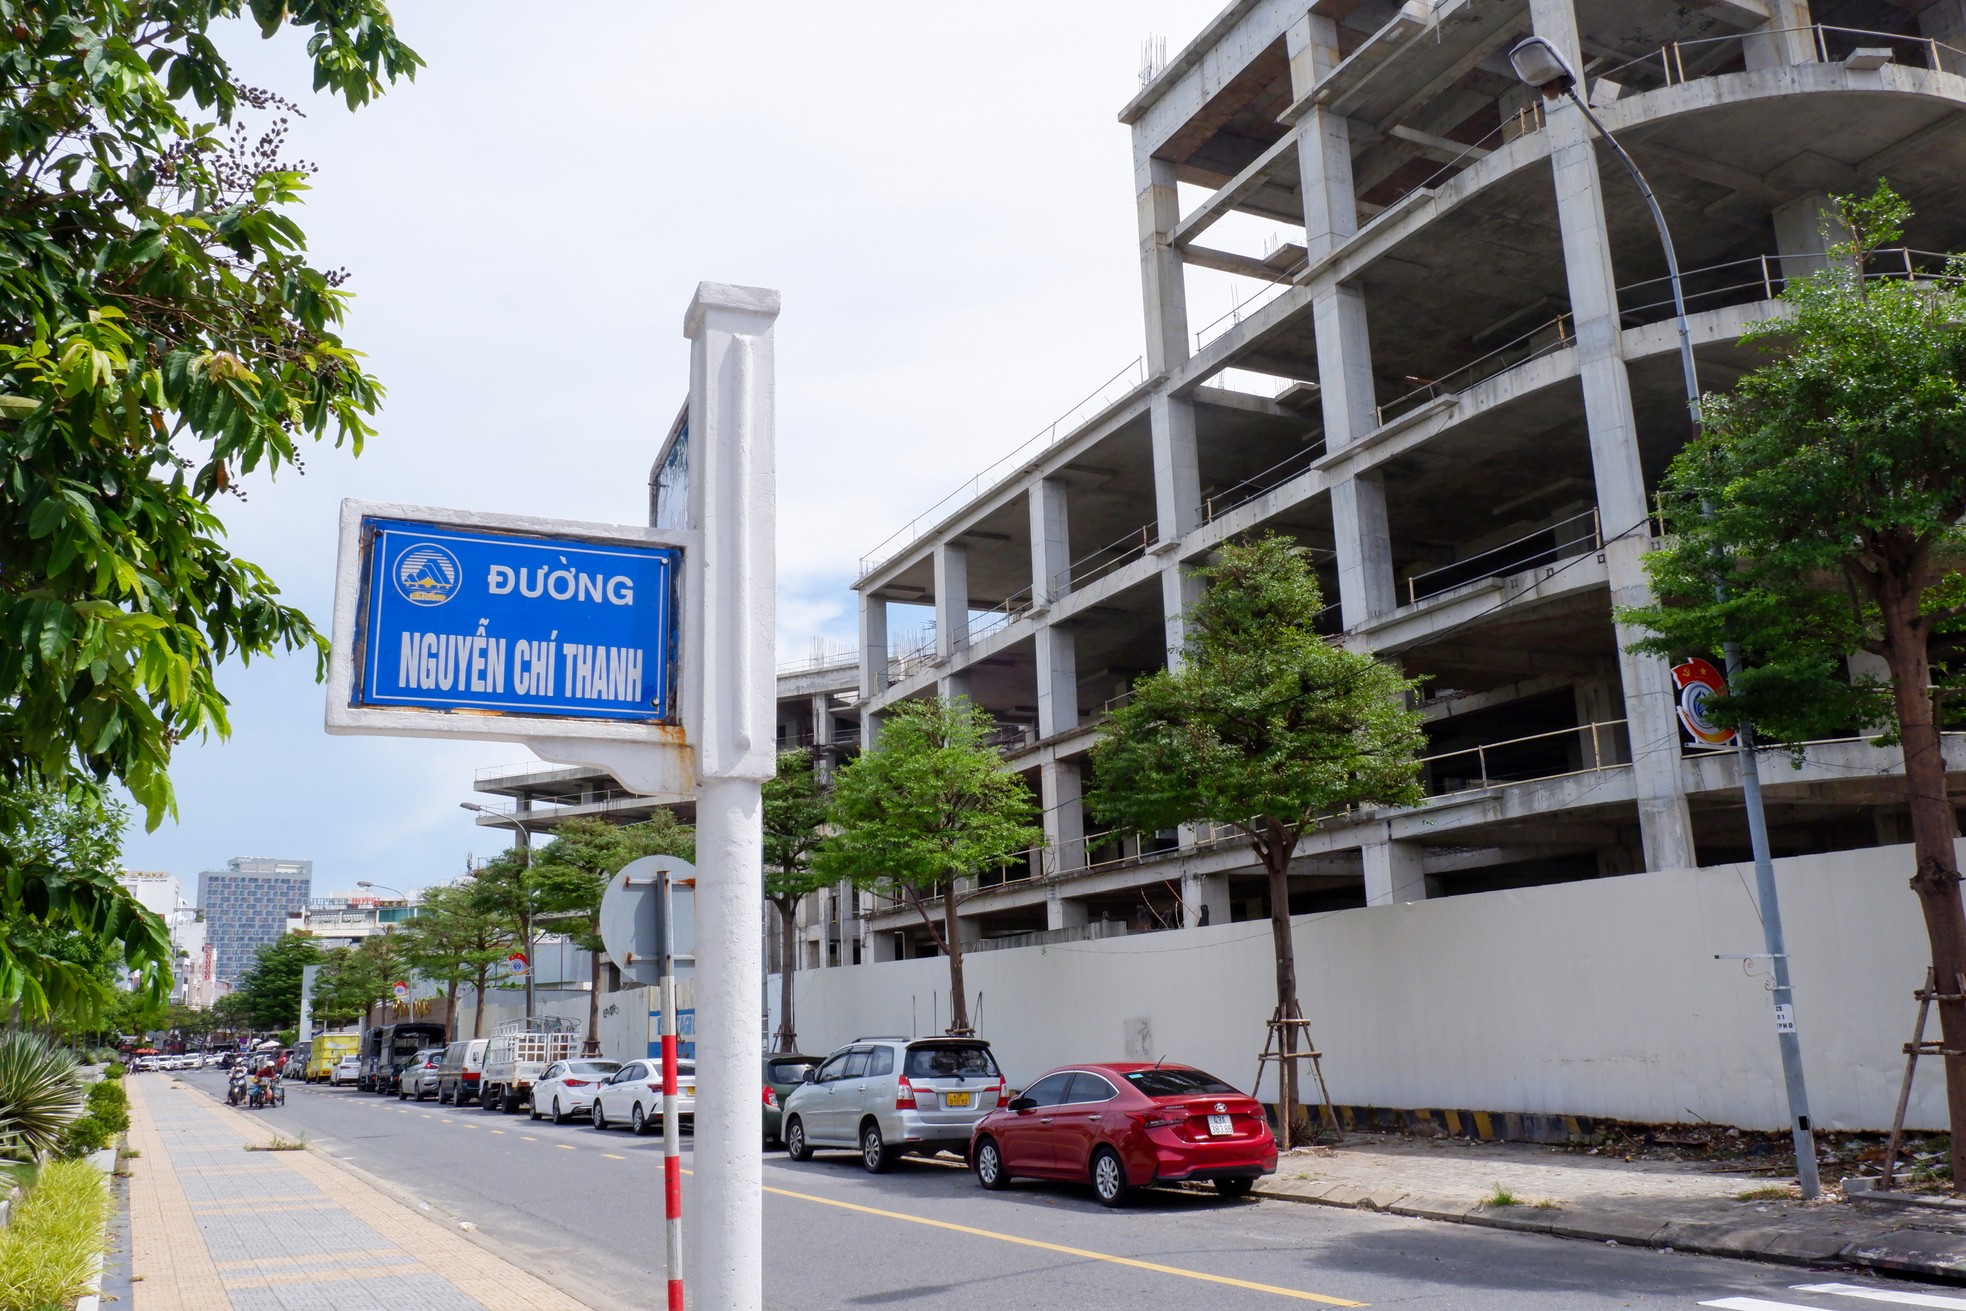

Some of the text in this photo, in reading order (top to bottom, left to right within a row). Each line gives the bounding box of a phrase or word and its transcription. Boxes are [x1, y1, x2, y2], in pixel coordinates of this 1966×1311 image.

[488, 556, 634, 606] ĐƯỜNG
[399, 618, 643, 702] NGUYỄN CHÍ THANH
[351, 897, 381, 905] HOTEL
[1213, 1115, 1227, 1124] 43A
